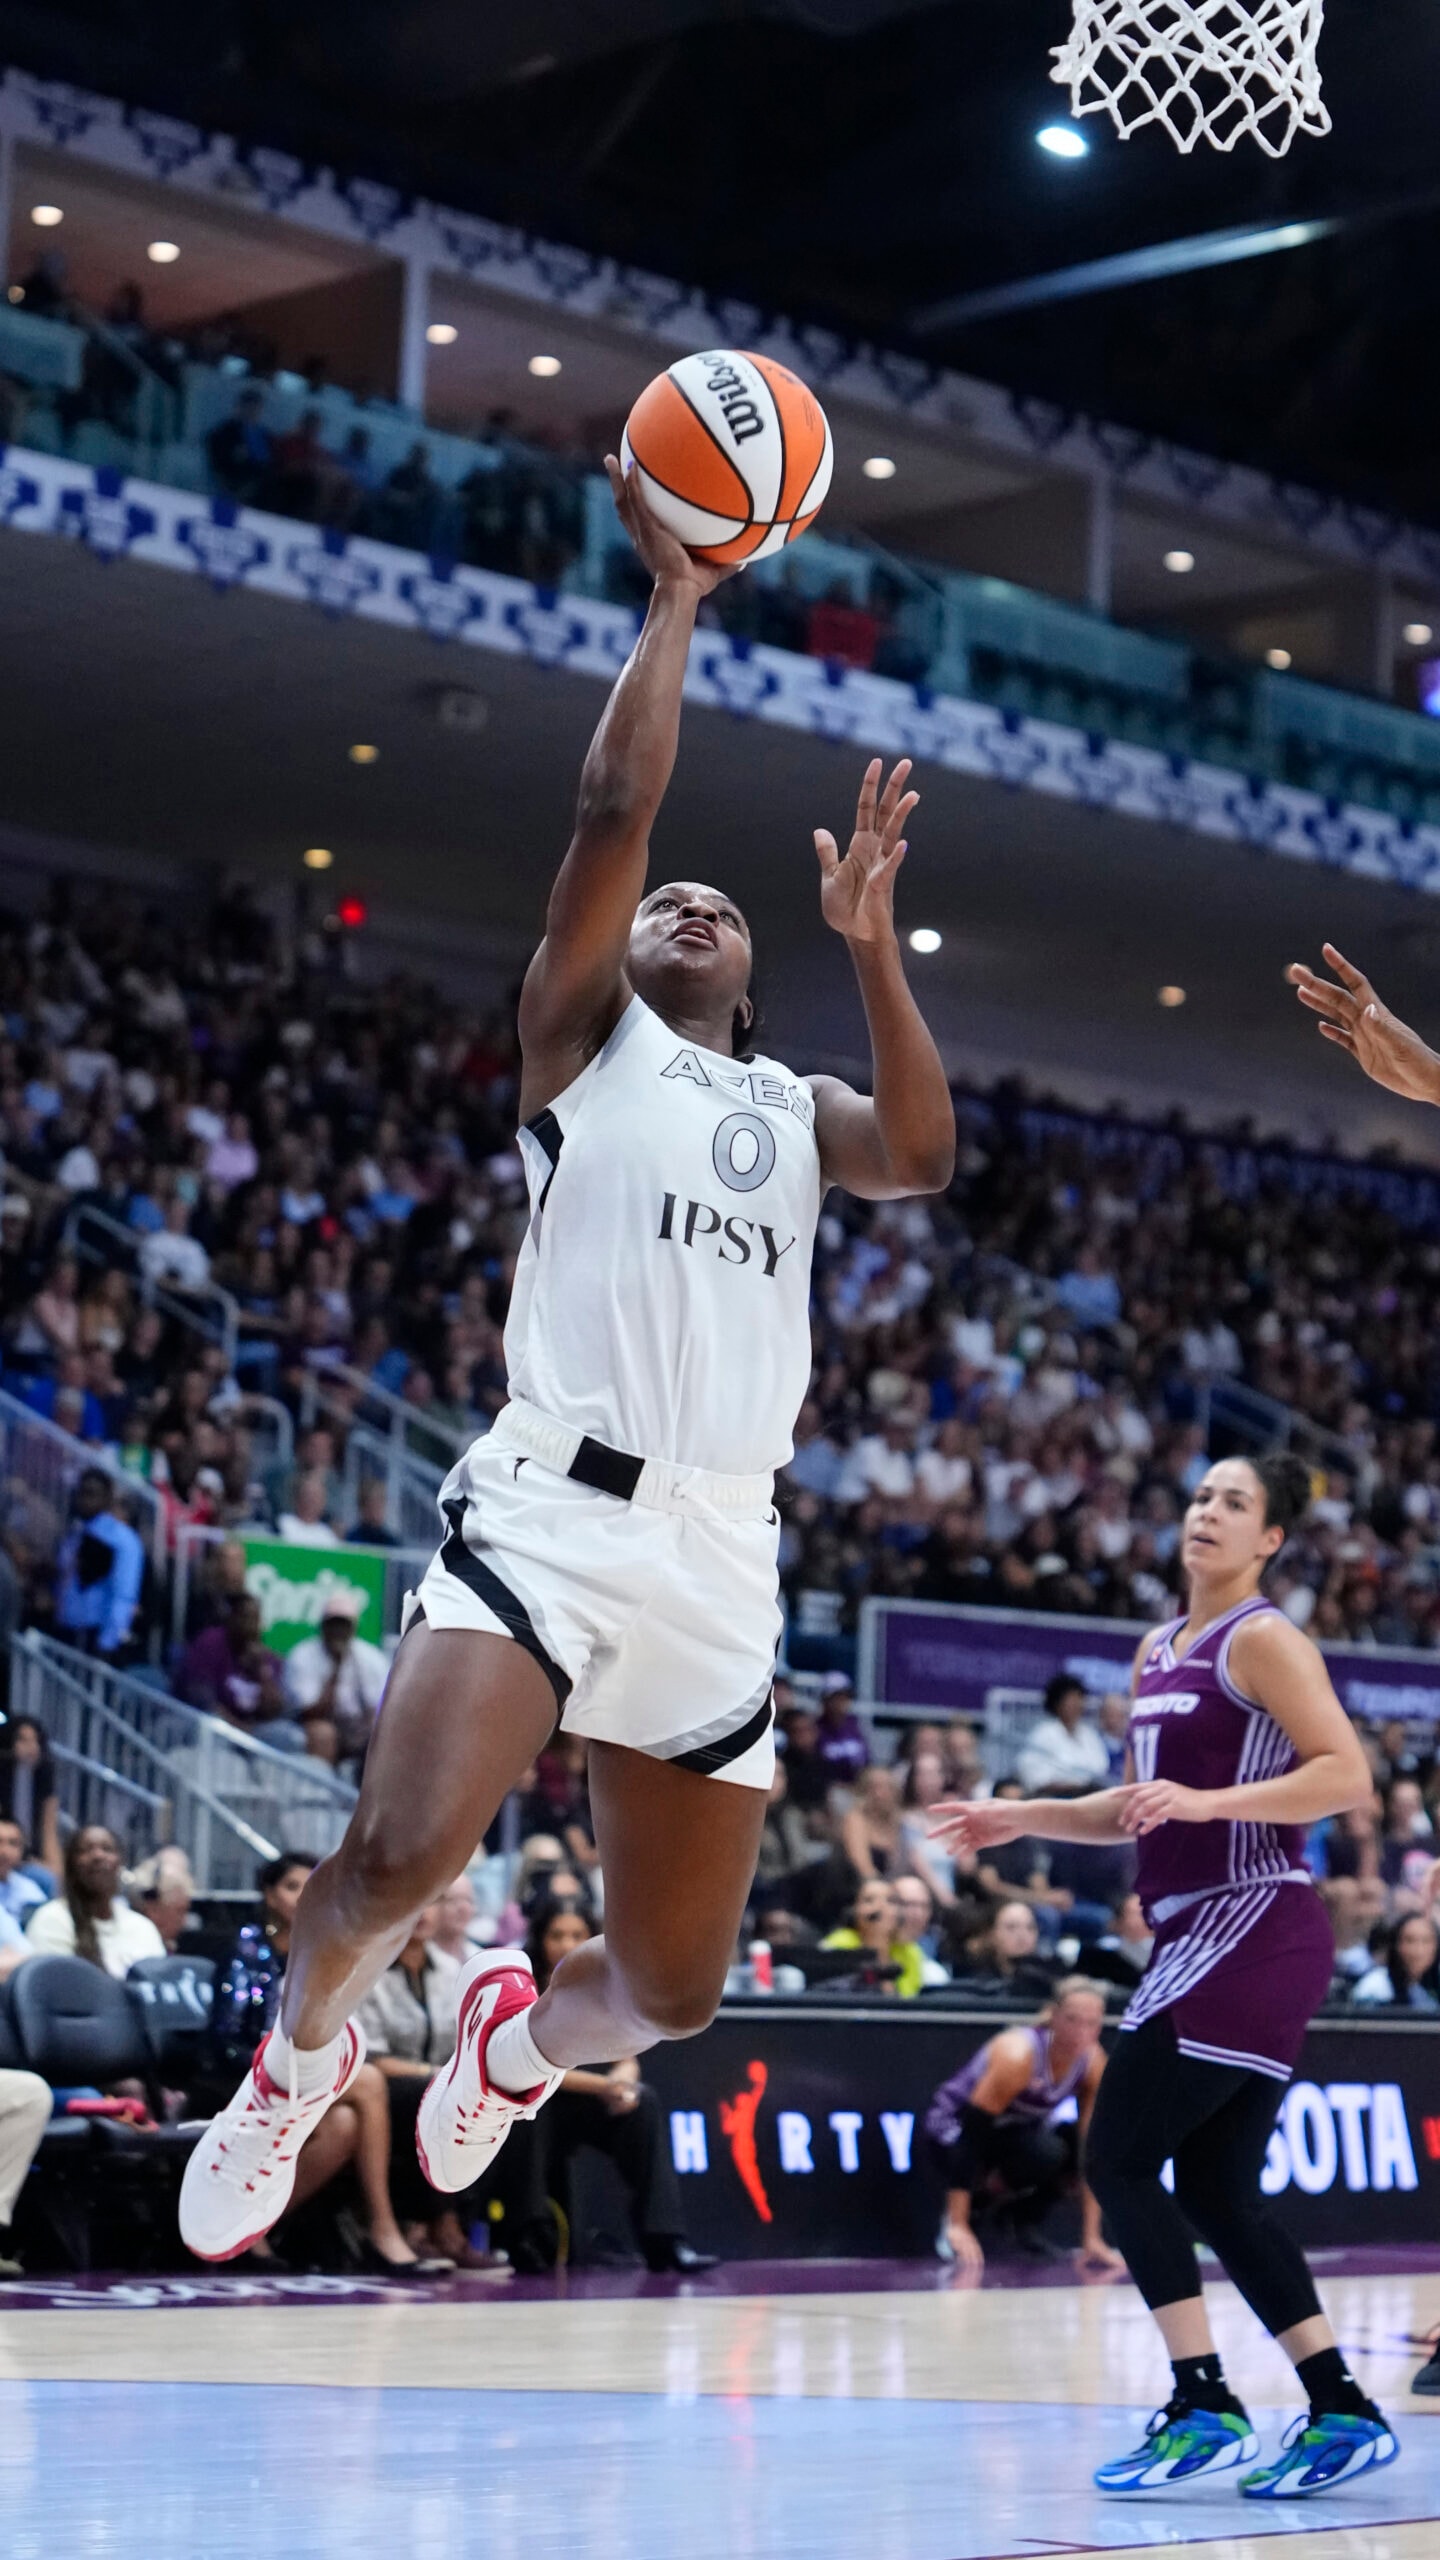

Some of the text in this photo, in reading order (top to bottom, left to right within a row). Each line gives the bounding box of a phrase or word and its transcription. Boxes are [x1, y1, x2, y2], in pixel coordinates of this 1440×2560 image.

[698, 352, 765, 447] Wilso
[660, 1049, 810, 1130] ACES
[712, 1112, 776, 1193] 0
[657, 1191, 796, 1278] IPSY
